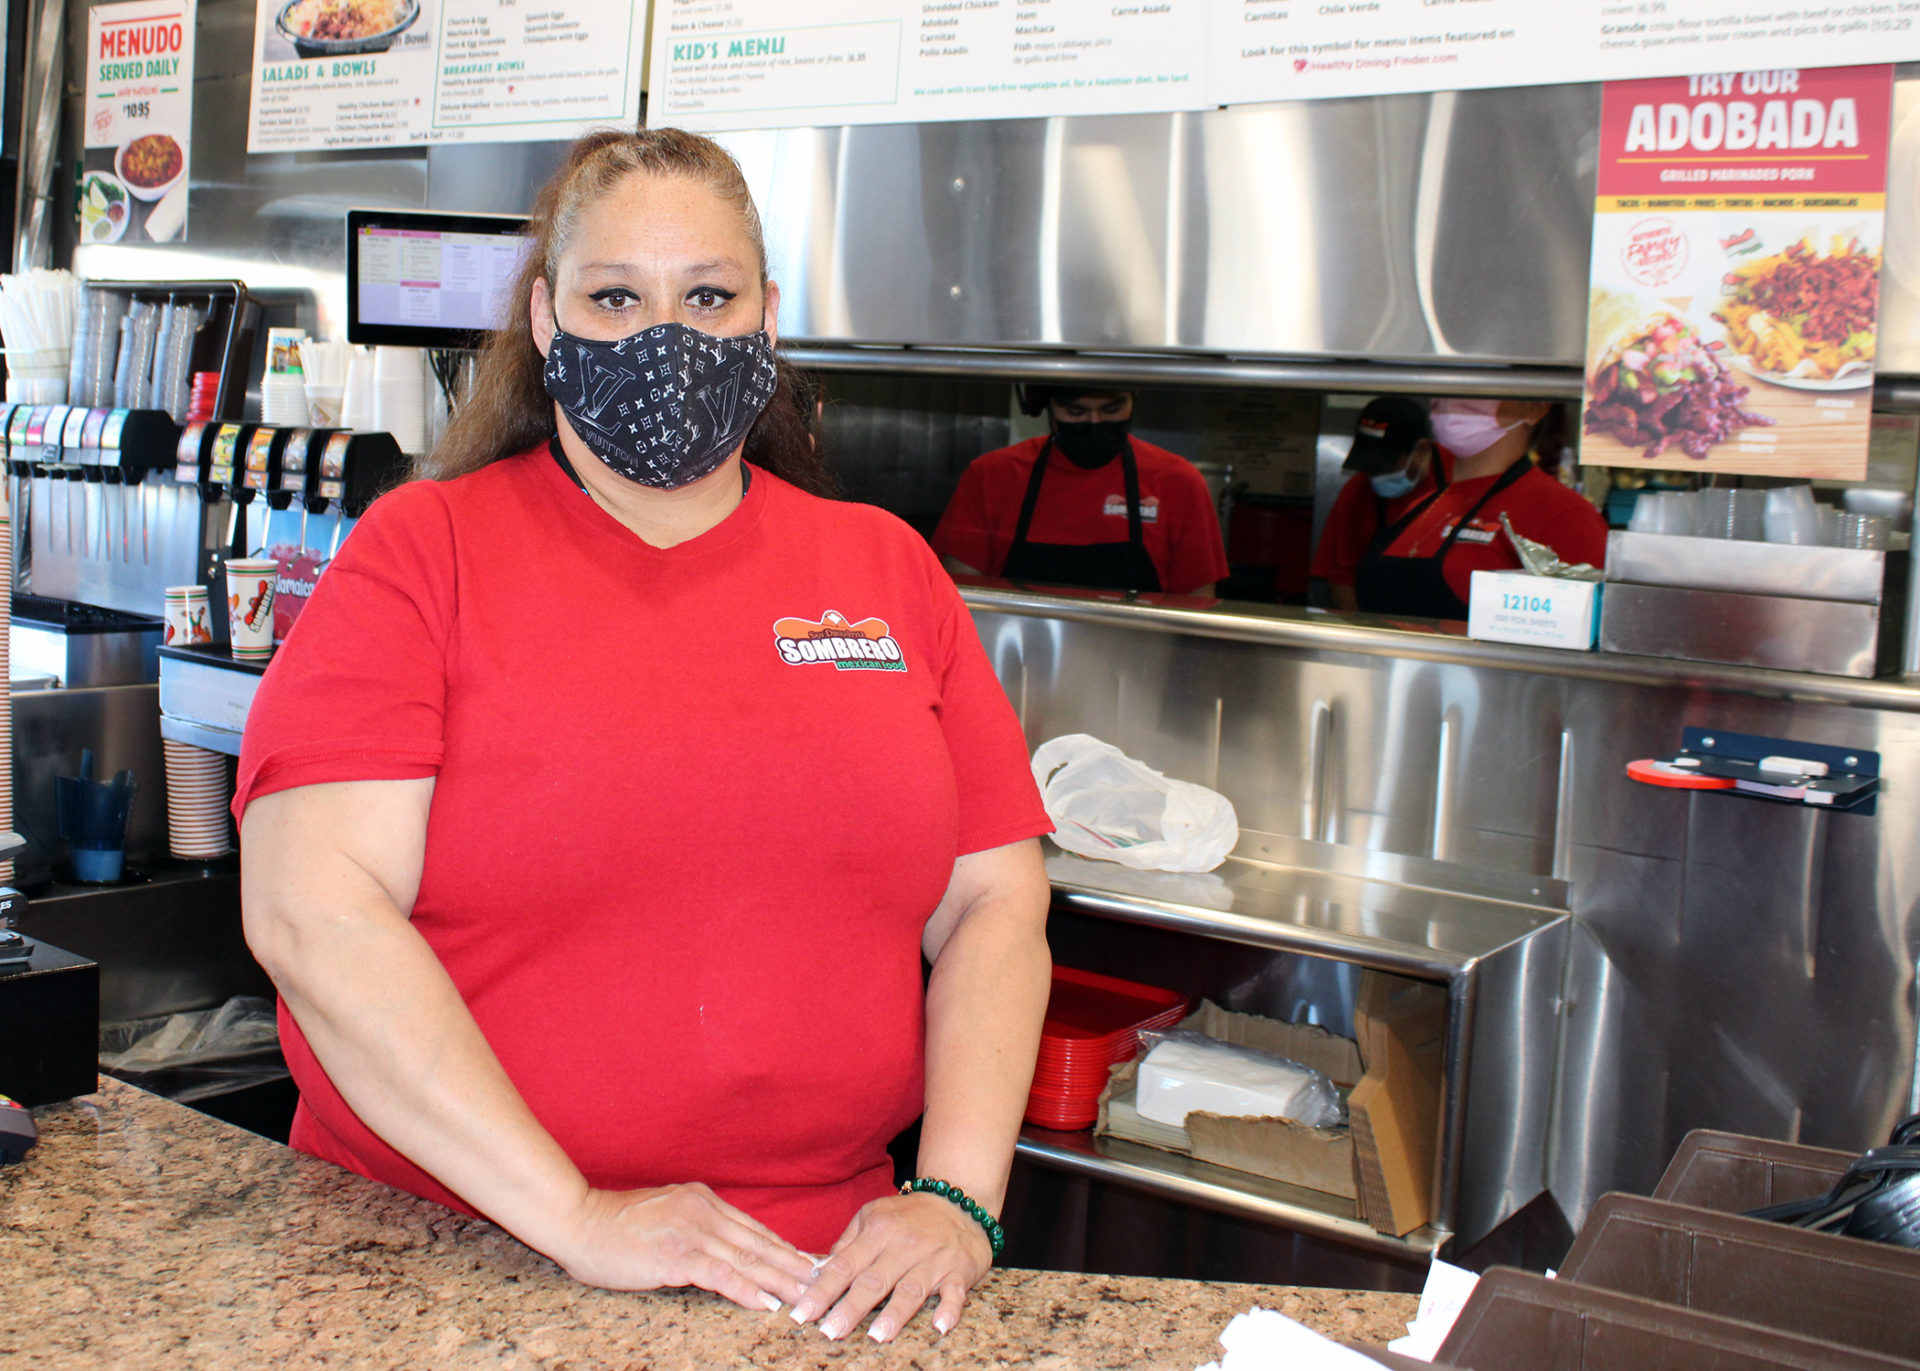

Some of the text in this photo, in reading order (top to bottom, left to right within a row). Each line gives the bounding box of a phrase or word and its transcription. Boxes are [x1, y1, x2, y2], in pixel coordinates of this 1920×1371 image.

[922, 3, 963, 13] Shredded
[1112, 4, 1171, 17] Carne Asada
[1318, 2, 1380, 16] Chile Verde
[921, 17, 959, 28] Adobada
[1016, 11, 1038, 20] Ham
[1244, 11, 1288, 23] Carnitas
[671, 20, 724, 32] Bean & Cheese
[1015, 25, 1055, 35] Machaca
[1600, 22, 1647, 34] Grande
[1744, 12, 1771, 24] bowl
[1770, 26, 1792, 37] and
[1821, 23, 1836, 33] de
[100, 23, 182, 59] MENUDO
[404, 31, 428, 44] Bowl
[559, 32, 572, 40] with
[920, 33, 956, 42] Carnitas
[1241, 28, 1516, 58] Look for this symbol for menu items featured on
[674, 36, 786, 61] KID'S MENU
[920, 46, 968, 57] Pollo Asado
[1014, 42, 1032, 51] Fish
[671, 64, 692, 73] Served
[694, 62, 709, 71] with
[730, 60, 743, 69] and
[745, 58, 766, 68] choice
[768, 58, 777, 69] of
[794, 56, 815, 65] beans
[817, 56, 825, 64] or
[1012, 55, 1023, 64] de
[1044, 53, 1059, 63] and
[1311, 60, 1352, 71] Healthy
[1355, 58, 1391, 70] Dining
[100, 58, 180, 82] SERVED DAILY
[262, 60, 376, 82] SALADS & BOWLS
[444, 60, 525, 76] BREAKFAST BOWLS
[914, 88, 925, 96] We
[927, 86, 944, 95] cook
[946, 85, 964, 94] with
[966, 85, 985, 93] trans
[1018, 80, 1058, 92] vegetable
[1060, 79, 1072, 88] oil,
[1074, 78, 1086, 87] for
[1095, 76, 1134, 86] healthier
[1156, 74, 1168, 83] No
[1688, 70, 1800, 97] TRY OUR
[1624, 98, 1859, 152] ADOBADA
[1660, 169, 1709, 182] GRILLED
[1780, 167, 1816, 181] PORK
[1503, 593, 1552, 614] 12104
[779, 638, 901, 663] SOMBRERO
[837, 660, 906, 670] mexican food
